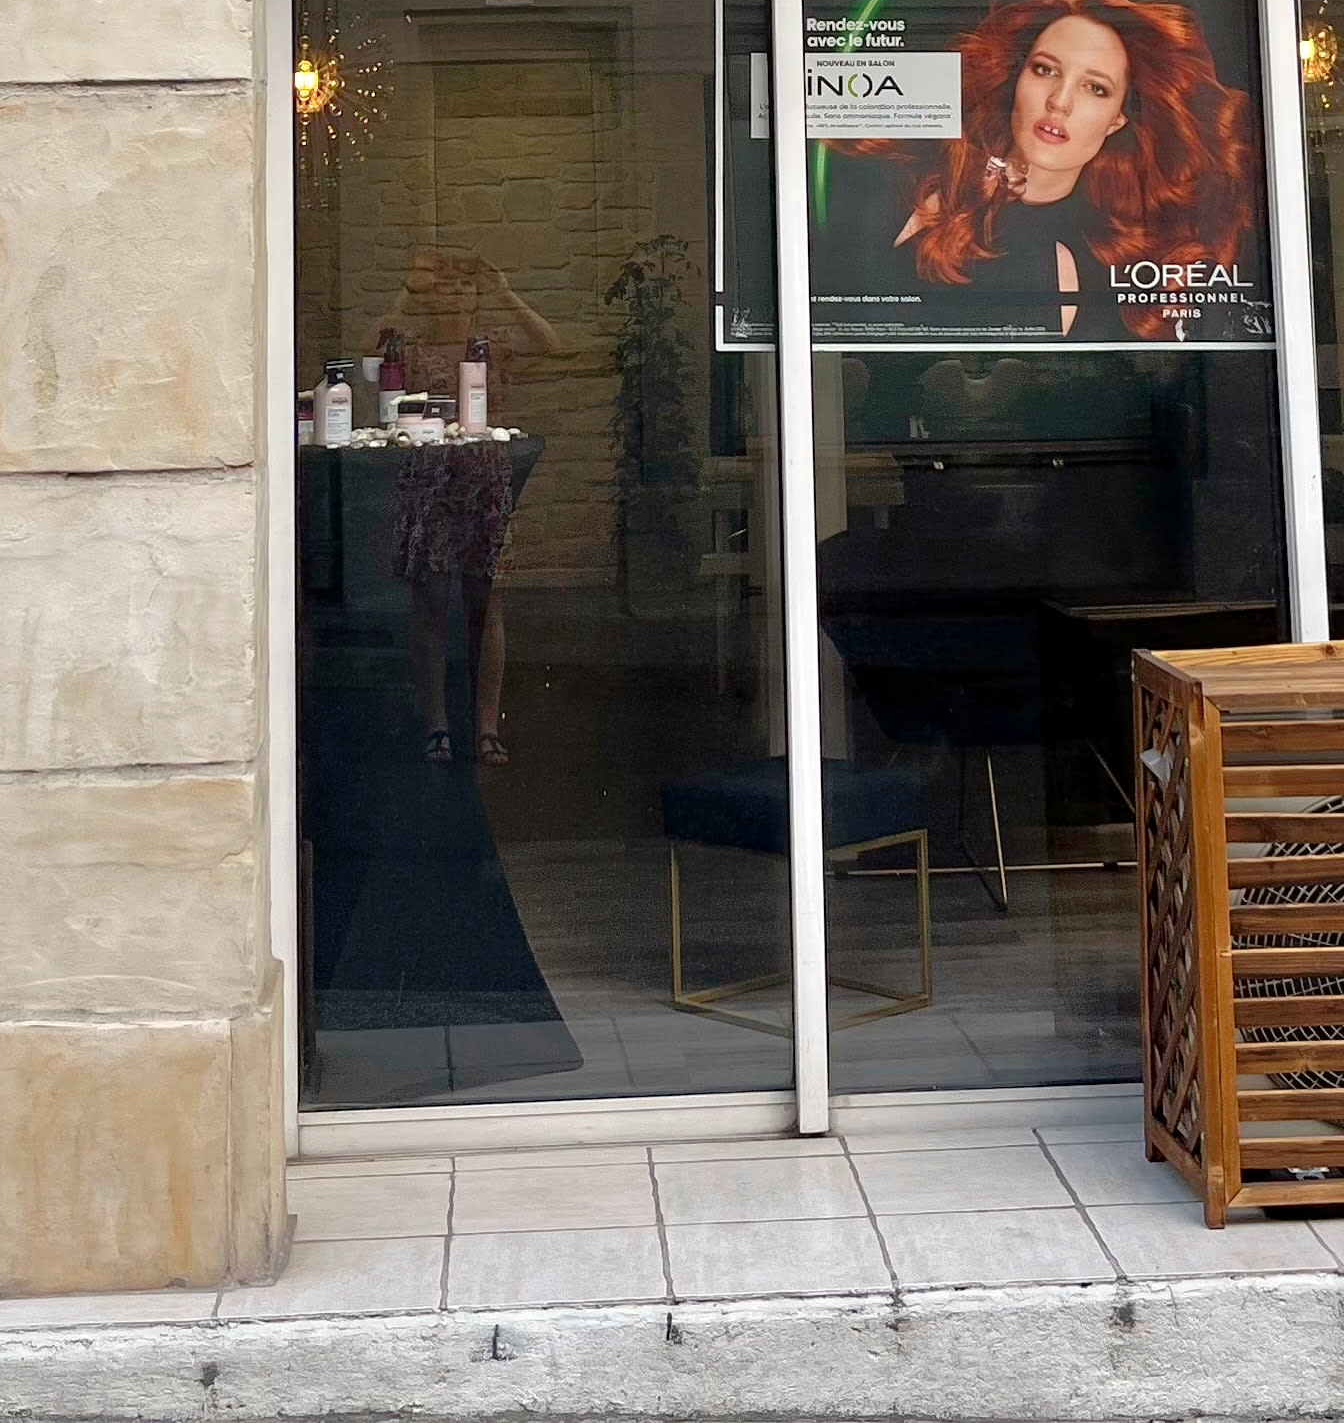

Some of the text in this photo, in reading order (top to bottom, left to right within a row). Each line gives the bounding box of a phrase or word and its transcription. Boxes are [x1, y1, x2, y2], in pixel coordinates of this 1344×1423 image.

[806, 17, 906, 32] Rendez-vous
[807, 32, 905, 47] avec le futur.
[868, 59, 896, 67] SALON
[1110, 261, 1254, 289] L'ORÉAL
[1117, 293, 1248, 304] PROFESSIONNEL
[1162, 308, 1202, 319] PARIS
